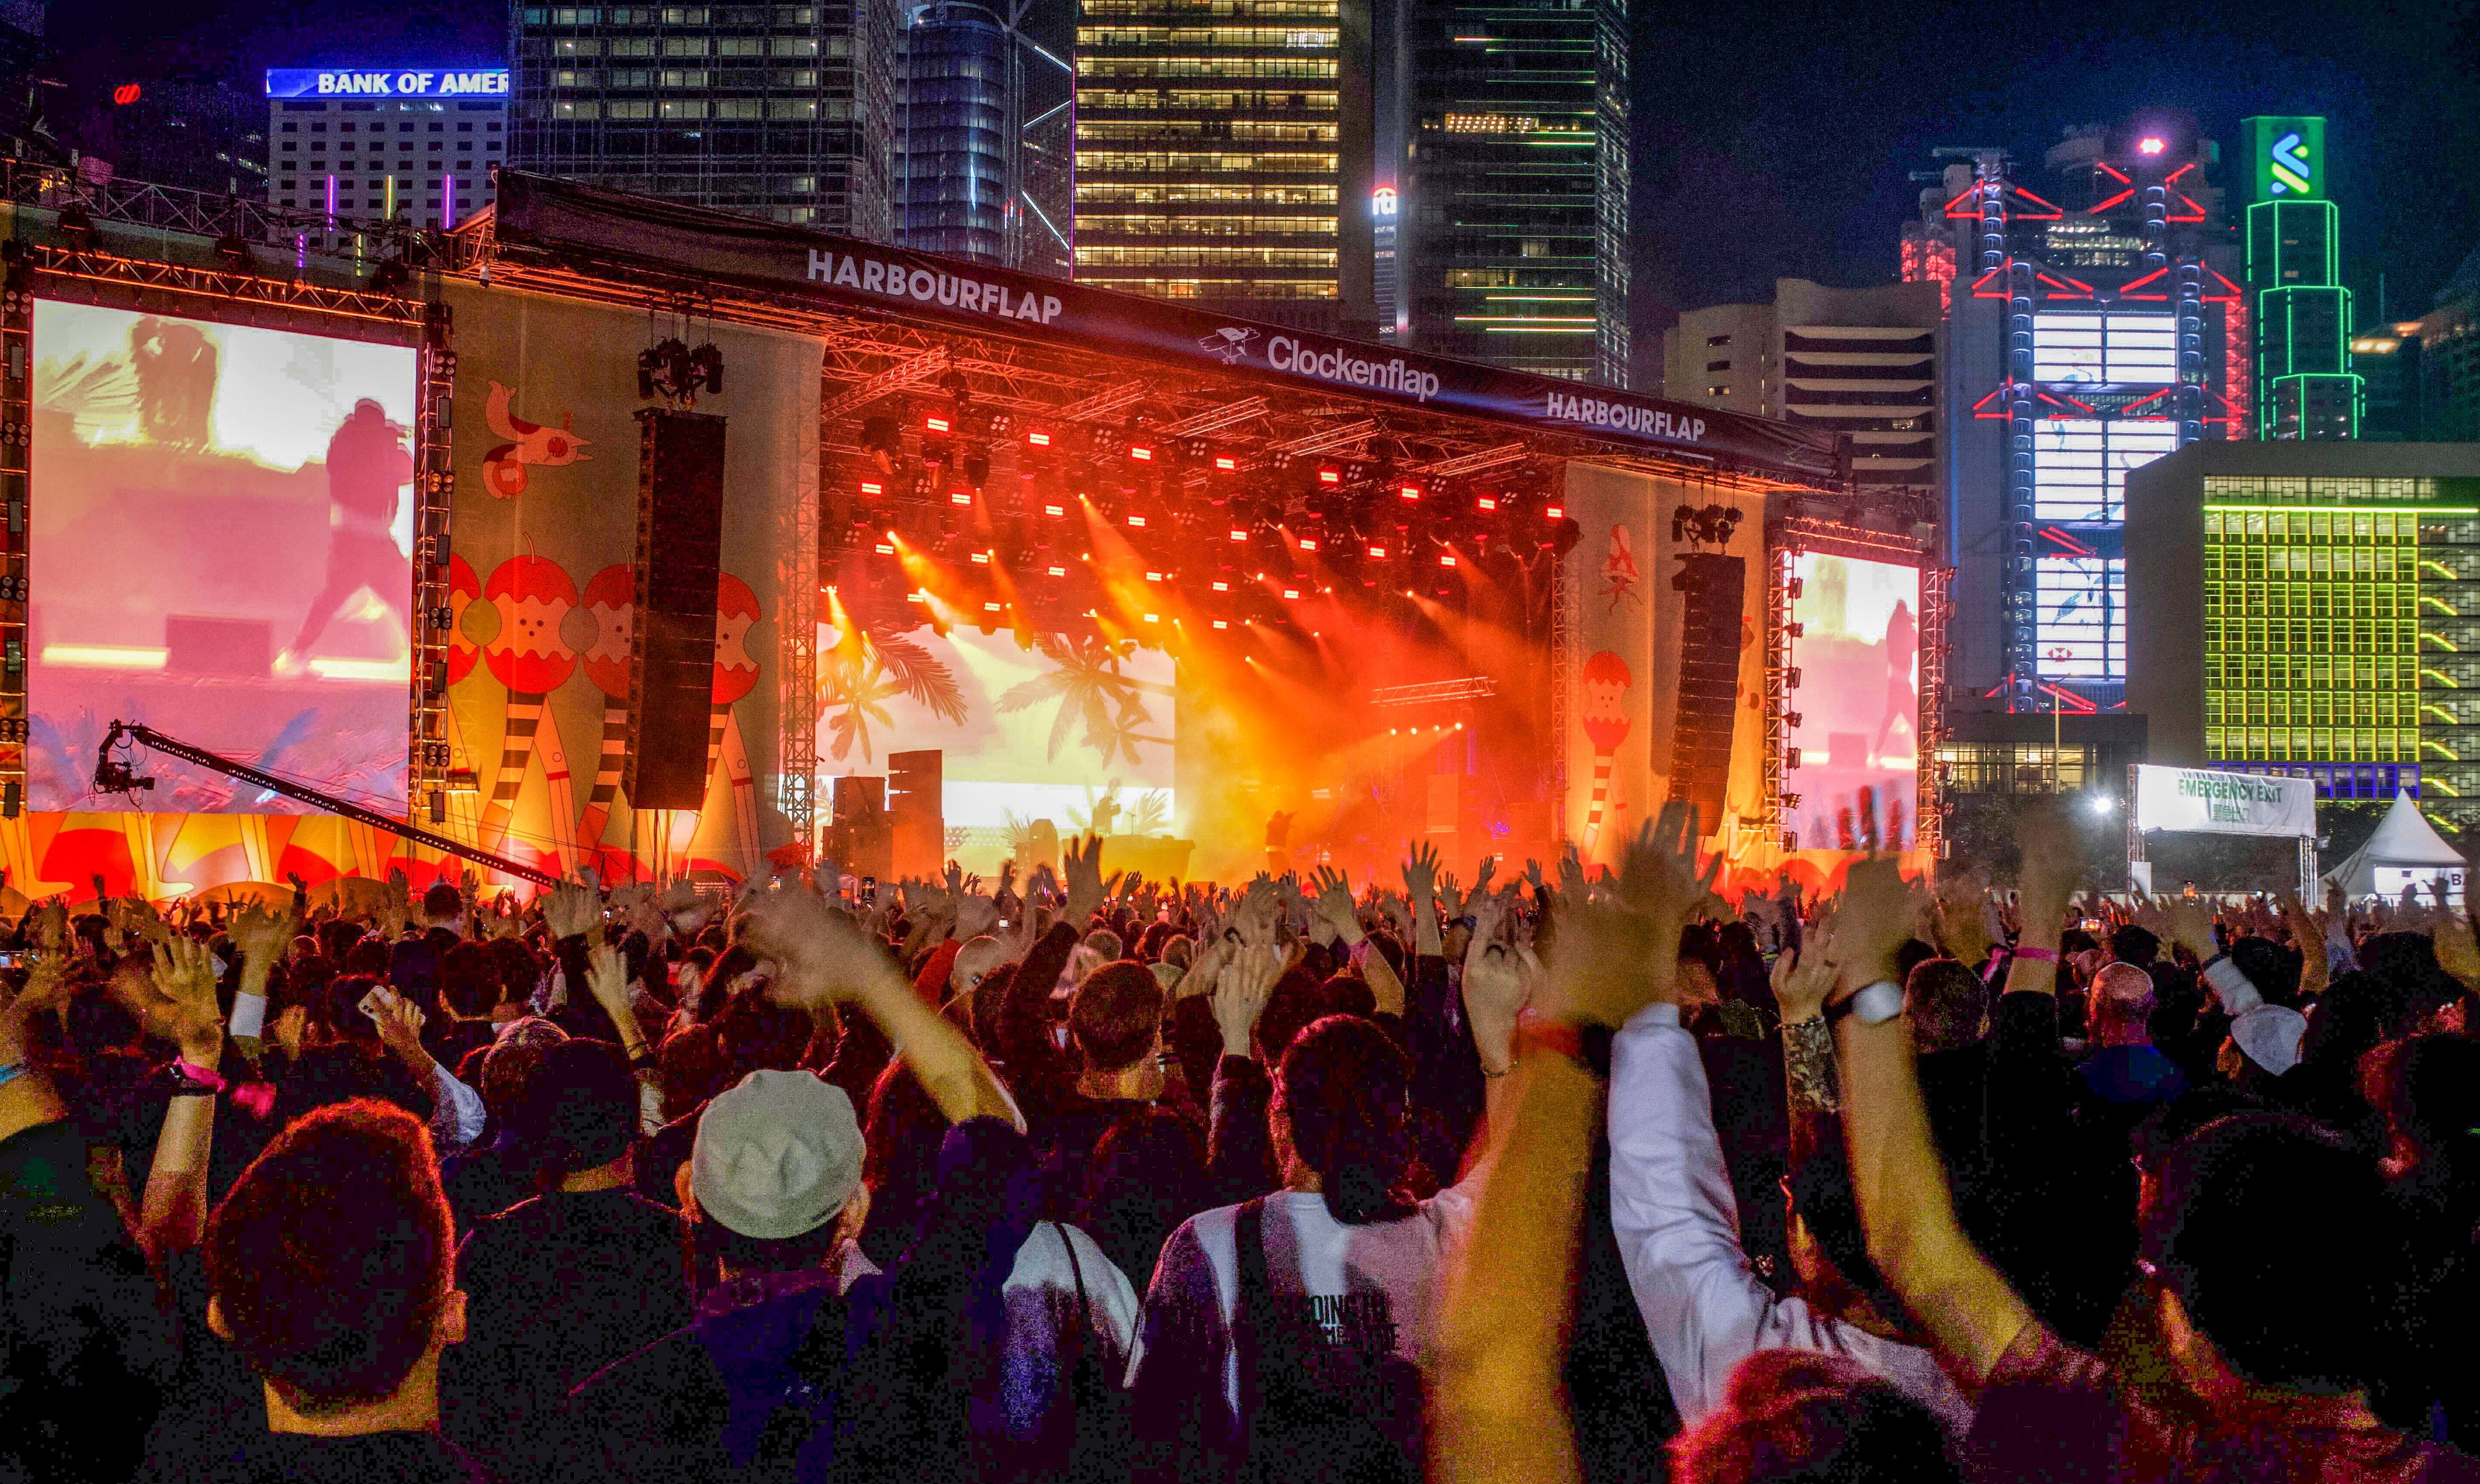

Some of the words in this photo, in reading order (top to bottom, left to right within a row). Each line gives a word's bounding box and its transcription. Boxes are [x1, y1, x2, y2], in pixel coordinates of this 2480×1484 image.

[318, 73, 391, 93] BANK
[397, 73, 434, 93] OF
[440, 73, 509, 93] AMER
[808, 249, 1063, 325] HARBOURFLAP
[1268, 335, 1439, 403] Clockenflap
[1546, 392, 1706, 442] HARBOURFLAP
[2178, 778, 2254, 801] EMERGENCY
[2257, 785, 2283, 803] EXIT
[2451, 874, 2464, 886] B
